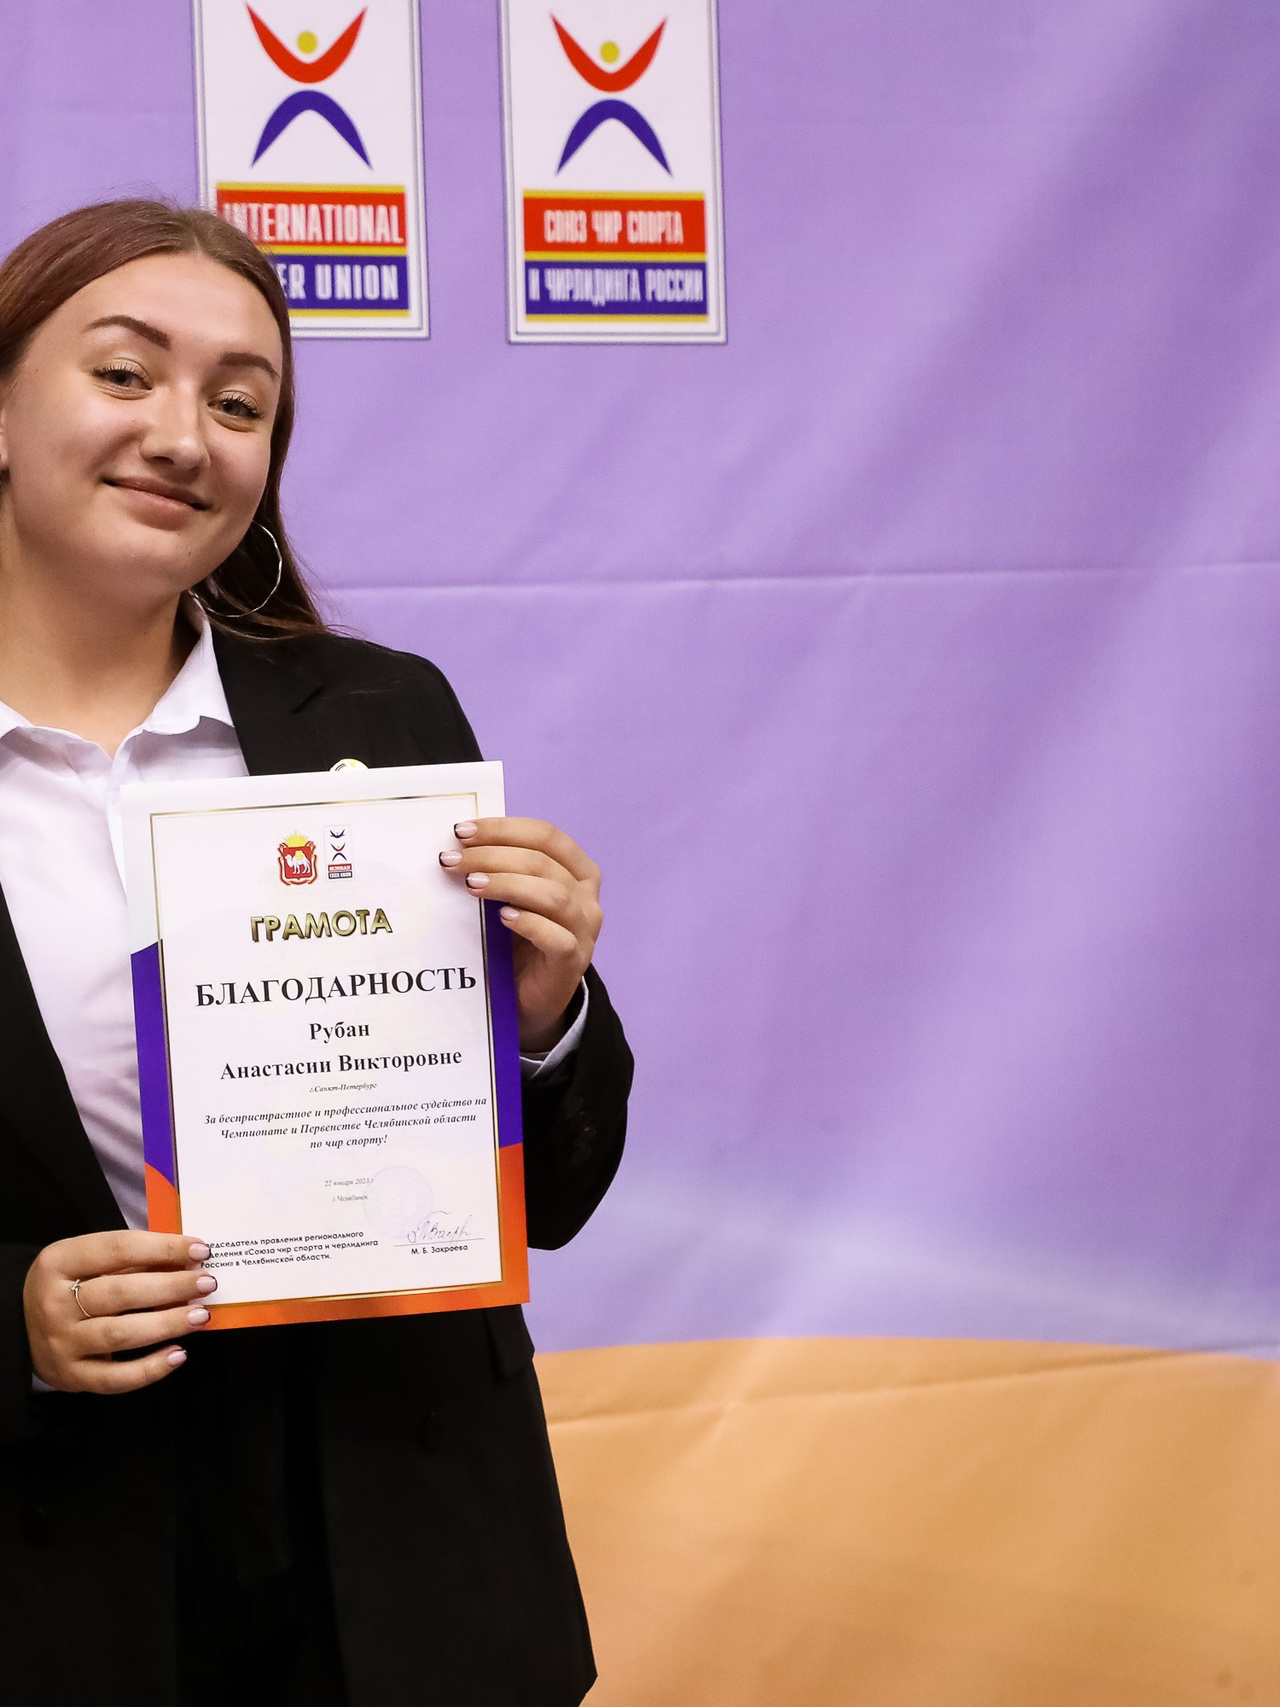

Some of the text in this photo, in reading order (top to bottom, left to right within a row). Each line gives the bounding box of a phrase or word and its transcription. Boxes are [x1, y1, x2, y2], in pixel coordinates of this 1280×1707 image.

[222, 203, 404, 243] INTERNATIONAL
[544, 210, 684, 244] СОЮЗ ЧИР СПОРТА
[315, 264, 399, 300] UNION
[528, 268, 703, 307] И ЧИРЛИДИНГА РОССИИ
[250, 908, 393, 942] ГРАМОТА
[195, 966, 477, 1006] БЛАГОДАРНОСТЬ
[308, 1021, 370, 1043] Рубан
[220, 1049, 462, 1080] Анастасии Викторовне
[204, 1113, 216, 1124] За
[219, 1106, 312, 1125] беспристрастное
[323, 1101, 418, 1119] профессиональное
[421, 1096, 472, 1111] судейство
[475, 1097, 487, 1105] на
[220, 1112, 476, 1140] Чемпионате и Первенстве Челябинской области
[310, 1134, 387, 1149] по чир спорту!
[206, 1231, 364, 1248] едседатель правления регионального
[276, 1245, 291, 1254] чир
[294, 1244, 323, 1253] спорта
[331, 1239, 378, 1251] черлидинга
[242, 1255, 294, 1266] Челябинской
